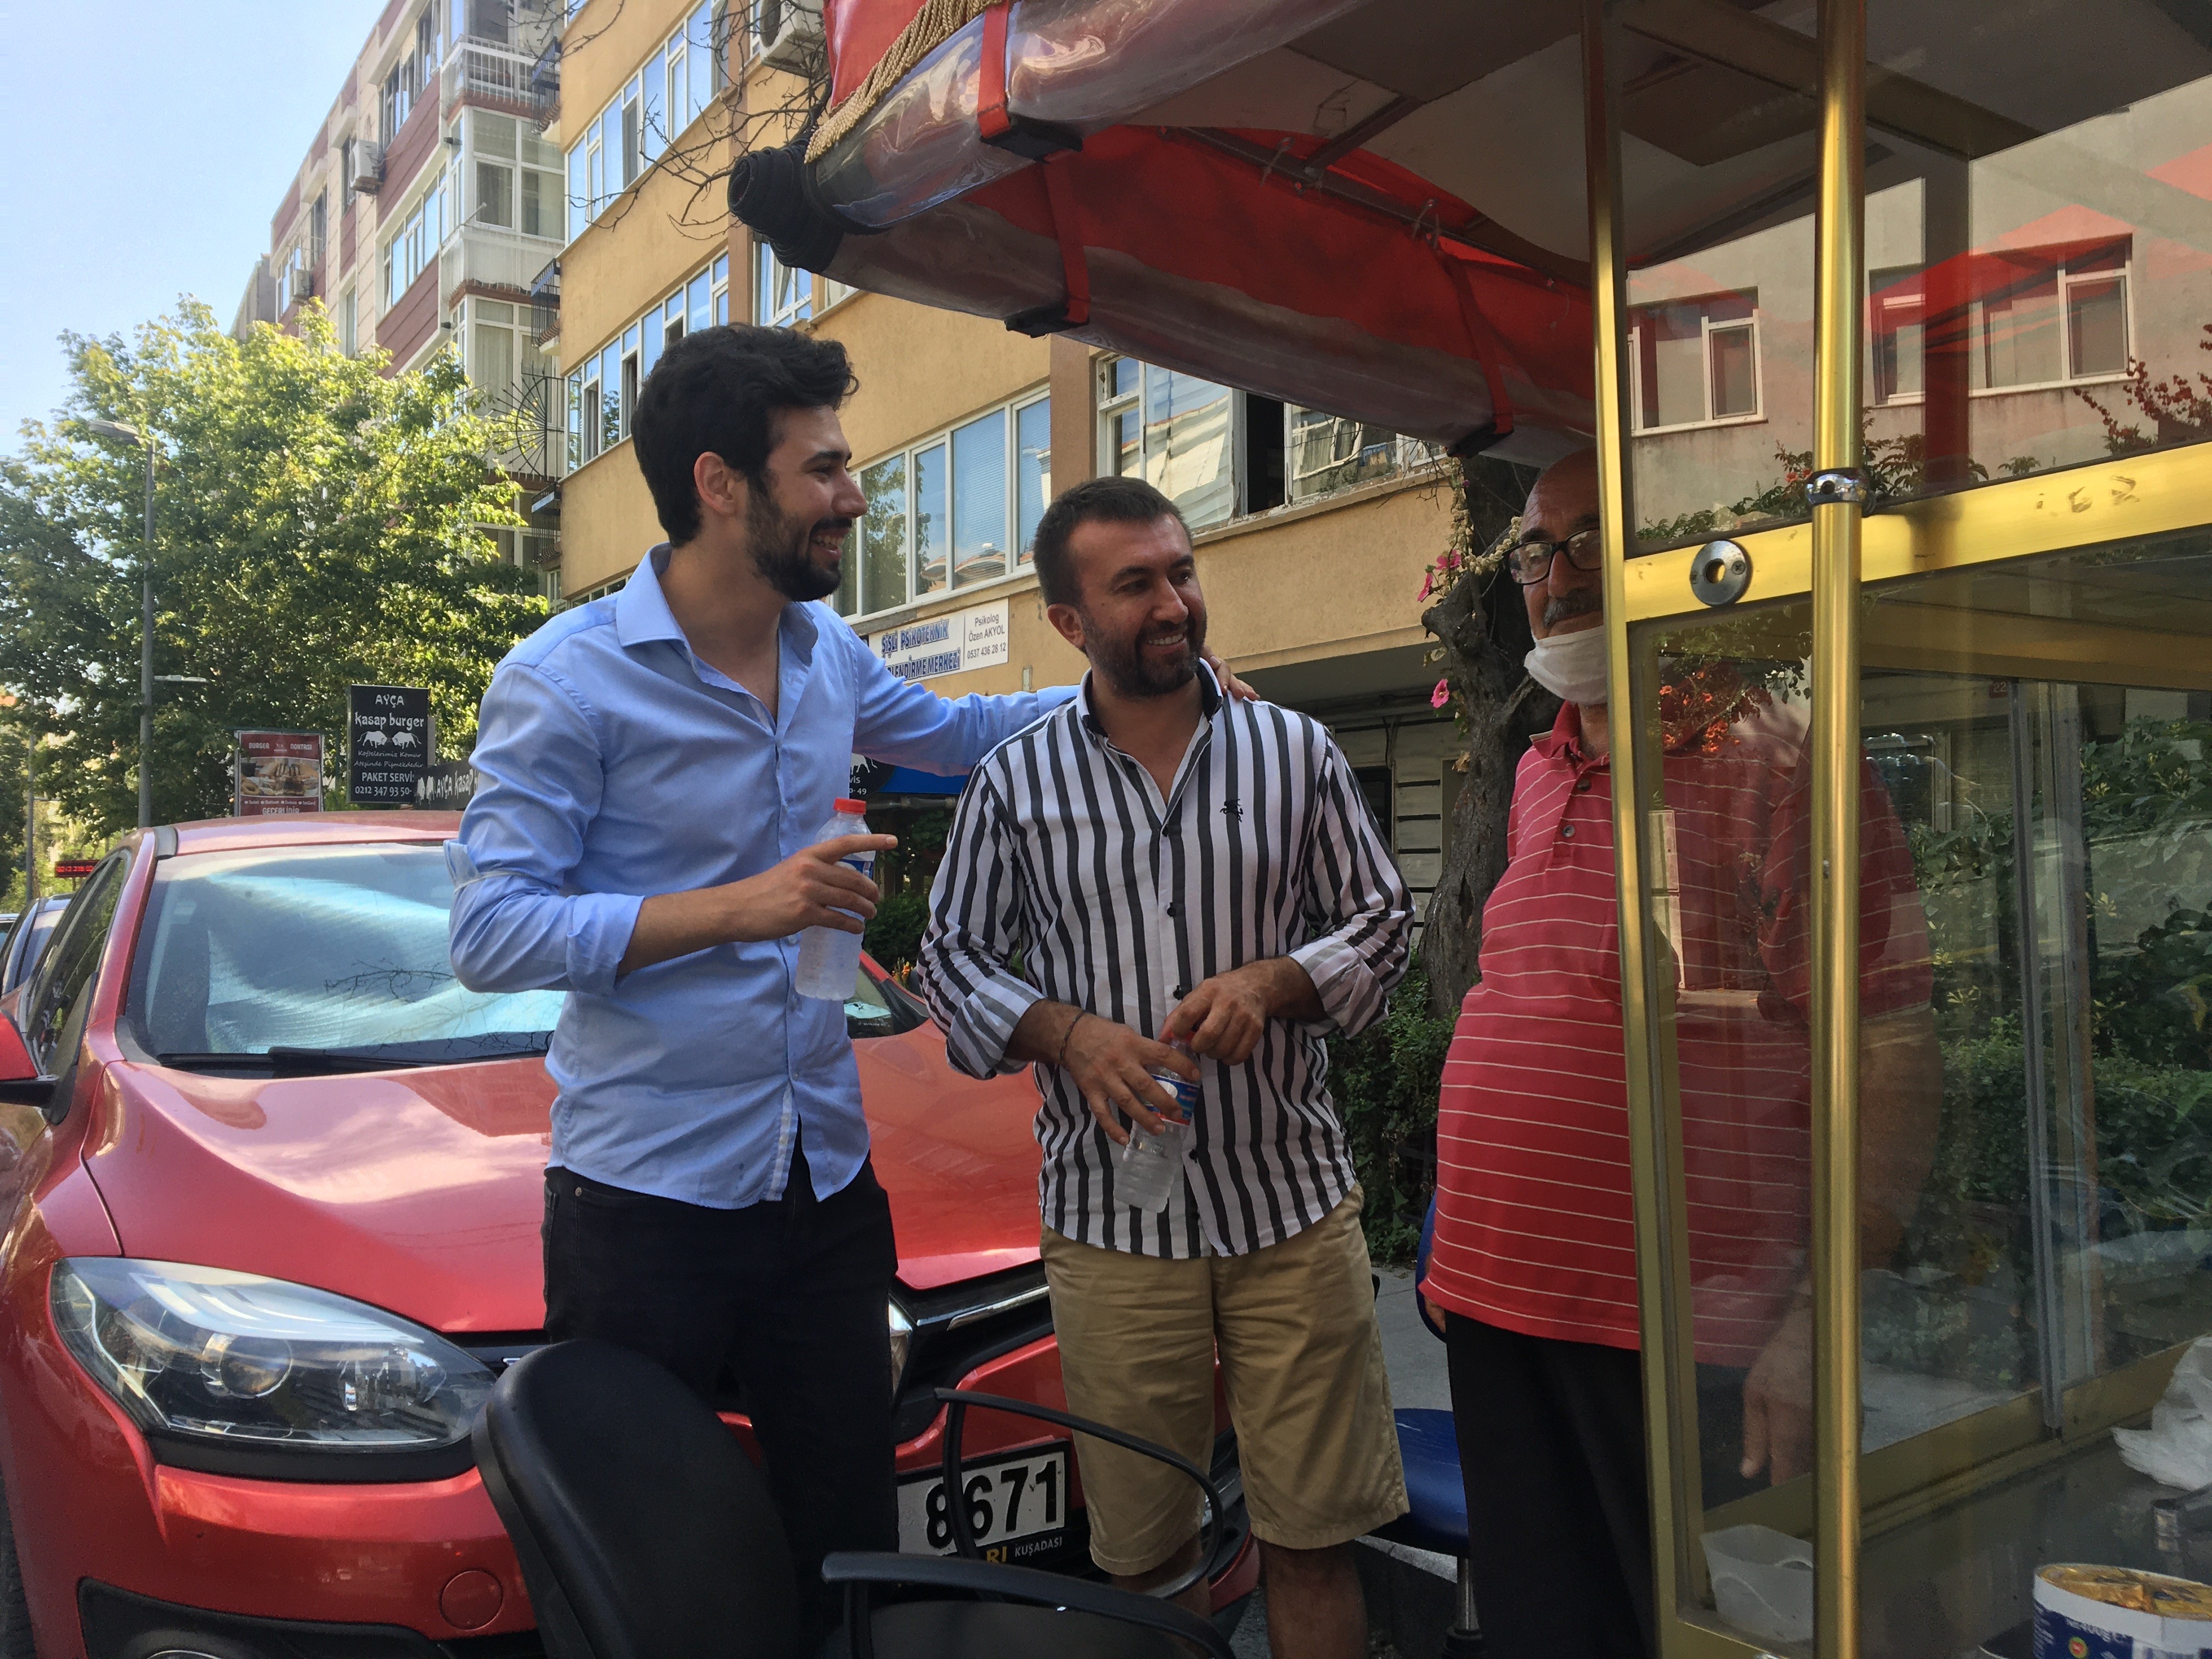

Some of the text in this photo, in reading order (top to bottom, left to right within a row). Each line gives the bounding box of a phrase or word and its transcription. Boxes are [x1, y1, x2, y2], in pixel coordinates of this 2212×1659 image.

[975, 613, 999, 627] Psikolog
[969, 624, 1005, 642] Özen AKYOL
[967, 642, 1006, 659] 0537 436 28 12
[375, 694, 404, 708] AYÇA
[355, 711, 424, 731] kasap burger
[362, 772, 388, 782] PAKET
[436, 774, 453, 799] AYÇA
[454, 769, 473, 799] kasap
[374, 786, 387, 797] 347
[390, 787, 399, 797] 93
[926, 1460, 1057, 1549] 8671
[1015, 1537, 1063, 1557] KUŞADASI
